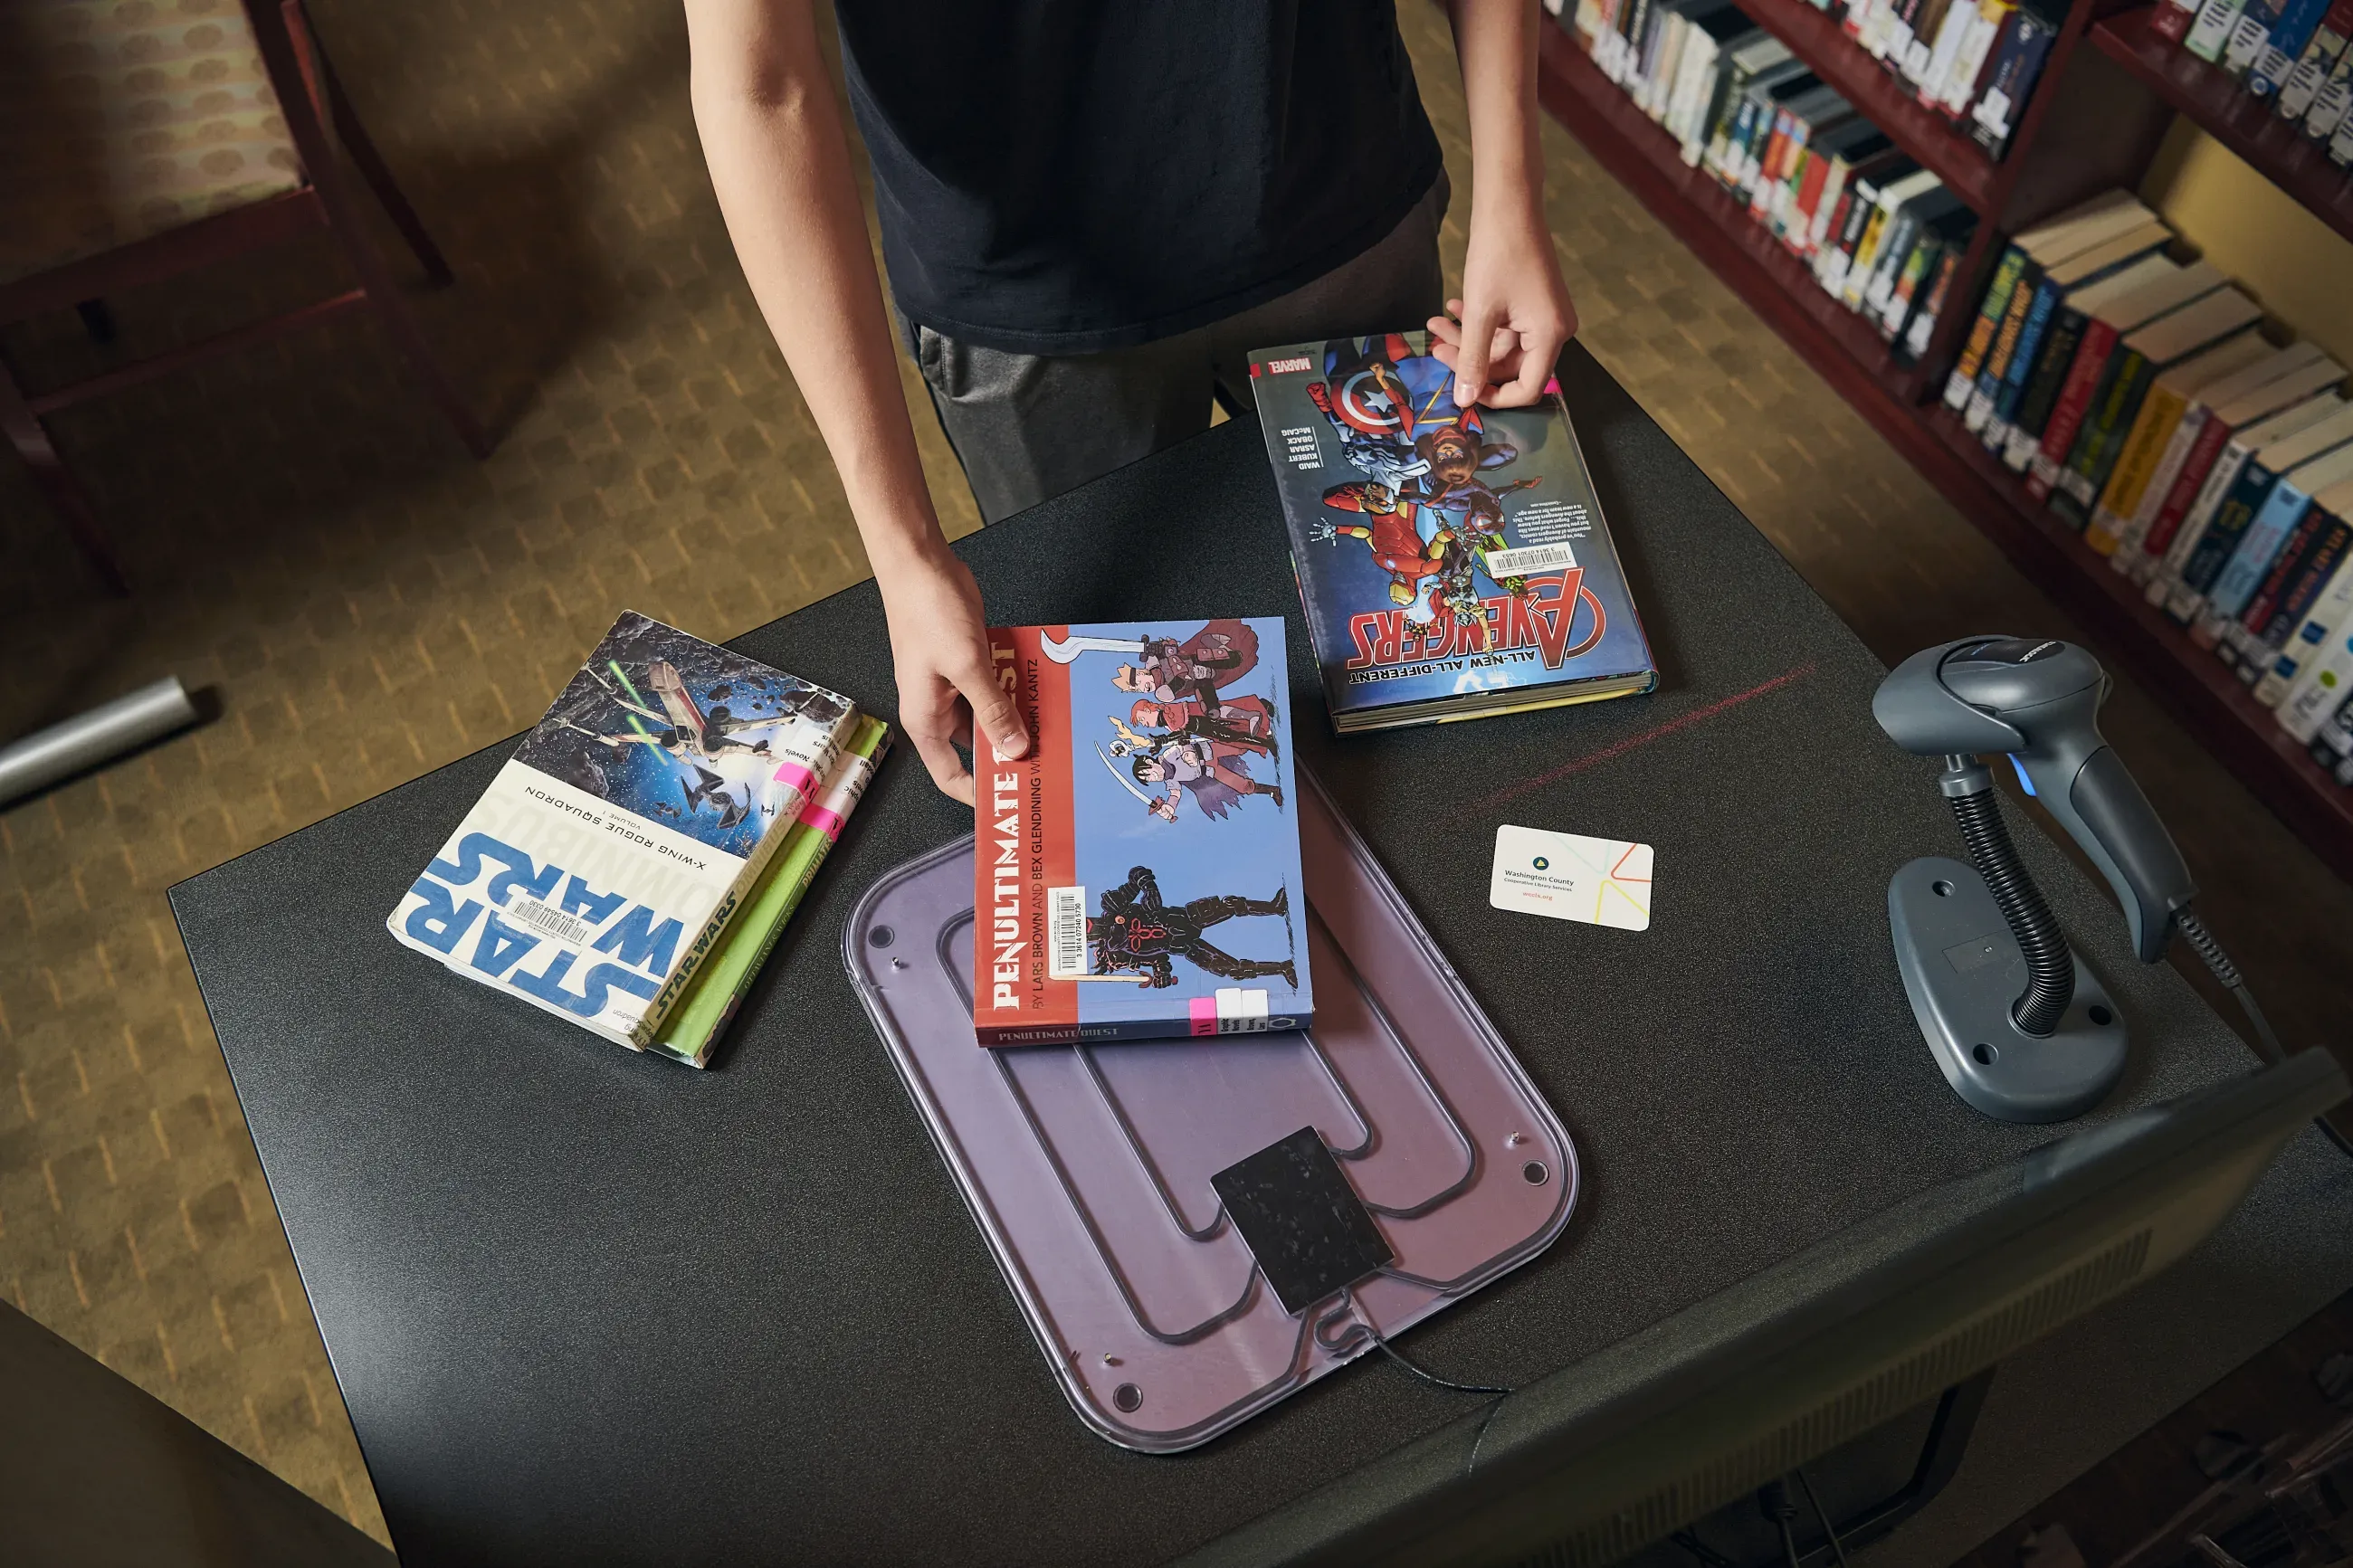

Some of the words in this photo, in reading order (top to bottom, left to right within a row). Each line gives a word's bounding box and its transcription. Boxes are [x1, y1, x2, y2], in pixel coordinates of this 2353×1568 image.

[1267, 357, 1310, 373] MARVEL
[1281, 427, 1311, 435] McCAIG
[1286, 435, 1313, 443] OBACK
[1287, 452, 1318, 461] KUBERT
[1289, 443, 1315, 452] ASRAR
[1543, 534, 1567, 542] probably
[1348, 567, 1606, 670] AVENGERS
[1467, 648, 1536, 670] ALL-NEW
[1027, 659, 1038, 700] KANTZ
[1347, 656, 1464, 686] ALL-DIFFERENT
[1028, 706, 1039, 740] JOHN
[785, 748, 810, 762] Novels
[1029, 744, 1040, 774] WITH
[523, 784, 603, 825] SQUADRON
[1030, 777, 1042, 853] GLENDINING
[608, 813, 642, 830] VOLUME
[604, 821, 654, 848] ROGUE
[656, 843, 707, 870] X-WING
[802, 834, 834, 888] PRIMATES
[1032, 856, 1042, 879] BEX
[1503, 878, 1533, 887] Cooperative
[1504, 870, 1547, 882] Washington
[1548, 876, 1574, 886] County
[992, 771, 1028, 1012] PENULTIMATE
[1032, 882, 1043, 908] AND
[1522, 891, 1552, 900] wccls.org
[424, 832, 683, 979] WARS
[528, 899, 544, 909] 0330
[543, 906, 562, 917] 04549
[560, 914, 576, 924] 3614
[776, 903, 795, 933] WICKS
[1032, 911, 1043, 958] BROWN
[403, 879, 662, 1018] STAR
[656, 956, 700, 1020] STAR
[692, 889, 736, 952] WARS
[1033, 961, 1043, 991] LARS
[1033, 993, 1043, 1009] BY
[998, 1030, 1075, 1041] PENULTIMATE
[1197, 1022, 1211, 1032] YA
[1221, 1018, 1229, 1031] Graphic
[1232, 1019, 1240, 1031] Novels
